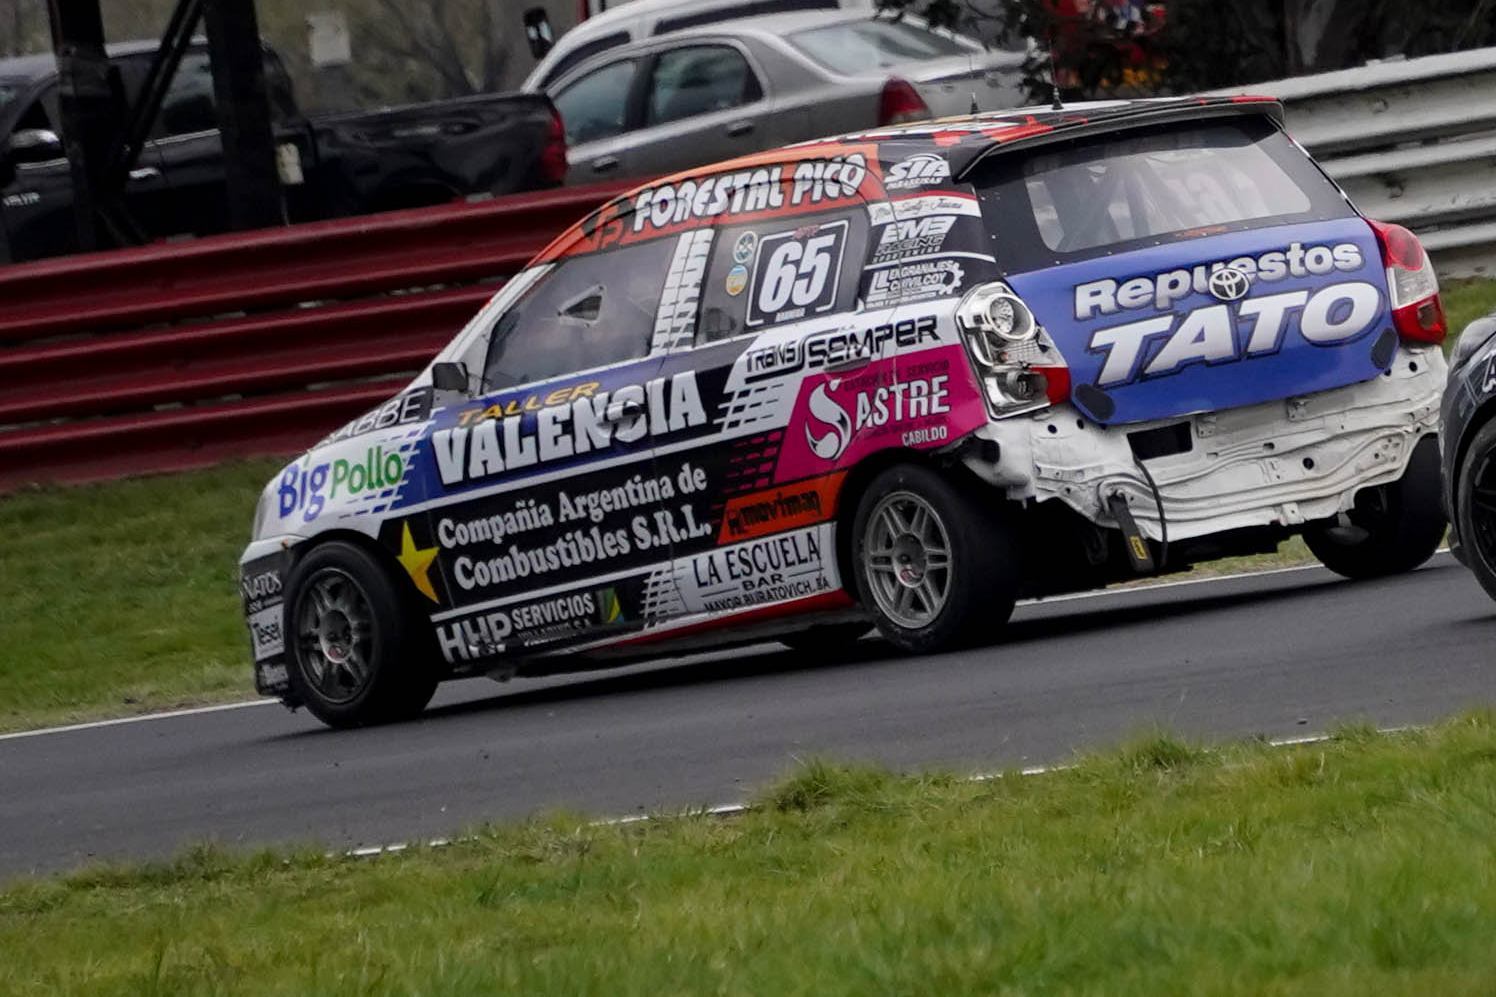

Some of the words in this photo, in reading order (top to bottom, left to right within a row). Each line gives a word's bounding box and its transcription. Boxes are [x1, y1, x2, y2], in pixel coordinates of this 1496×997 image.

[632, 165, 784, 232] FORESTAL
[791, 153, 866, 205] PICO
[758, 233, 837, 313] 65
[1074, 242, 1362, 320] Repuestos
[808, 315, 941, 369] SEMPER
[1090, 282, 1380, 386] TATO
[432, 370, 708, 485] VALENCIA
[459, 382, 600, 426] TALLER
[902, 425, 948, 447] CABILDO
[278, 463, 330, 522] Big
[330, 446, 403, 500] Pollo
[558, 474, 675, 523] Argentina
[678, 462, 707, 491] de
[454, 523, 631, 590] Combustibles
[631, 504, 712, 550] S.R.L.
[692, 555, 722, 589] LA
[725, 531, 822, 580] ESCUELA
[511, 592, 595, 631] SERVICIOS
[742, 572, 784, 592] BAR
